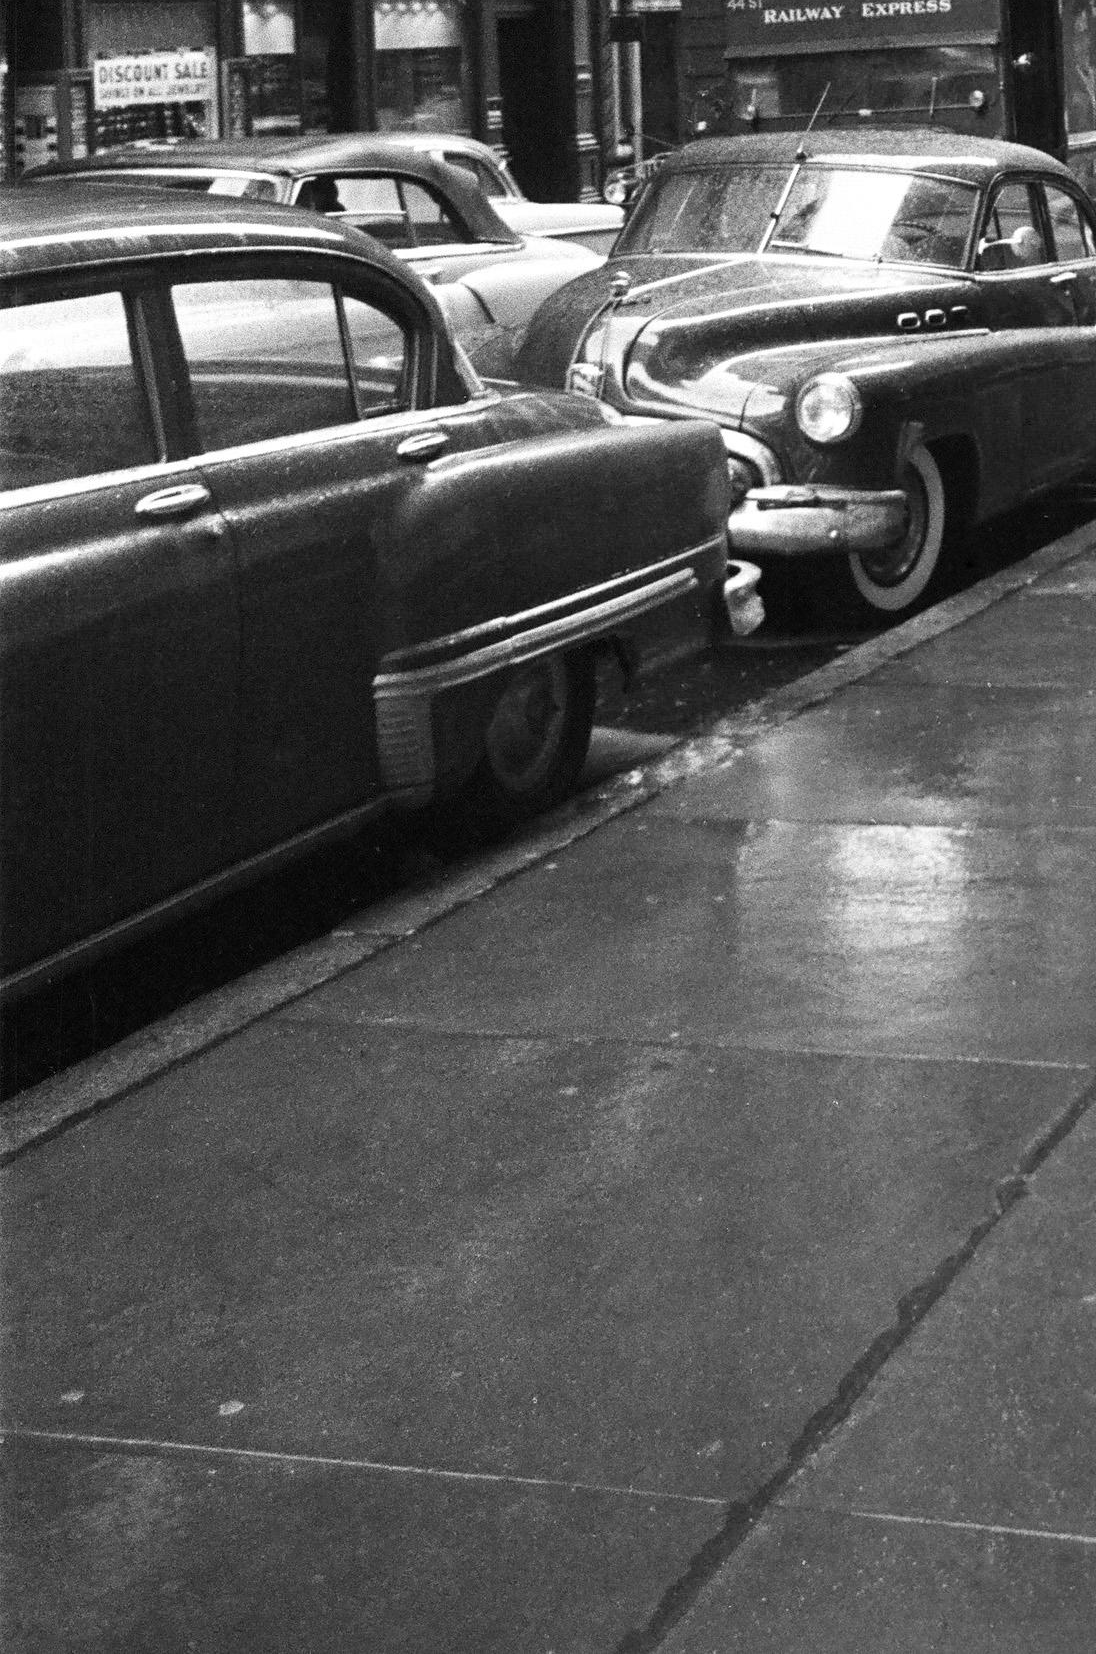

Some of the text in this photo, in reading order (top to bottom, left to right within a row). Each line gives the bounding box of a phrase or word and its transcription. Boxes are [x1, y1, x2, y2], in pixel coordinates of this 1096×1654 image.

[764, 6, 844, 24] RAILWAY
[98, 61, 208, 84] DISCOUNT SALE
